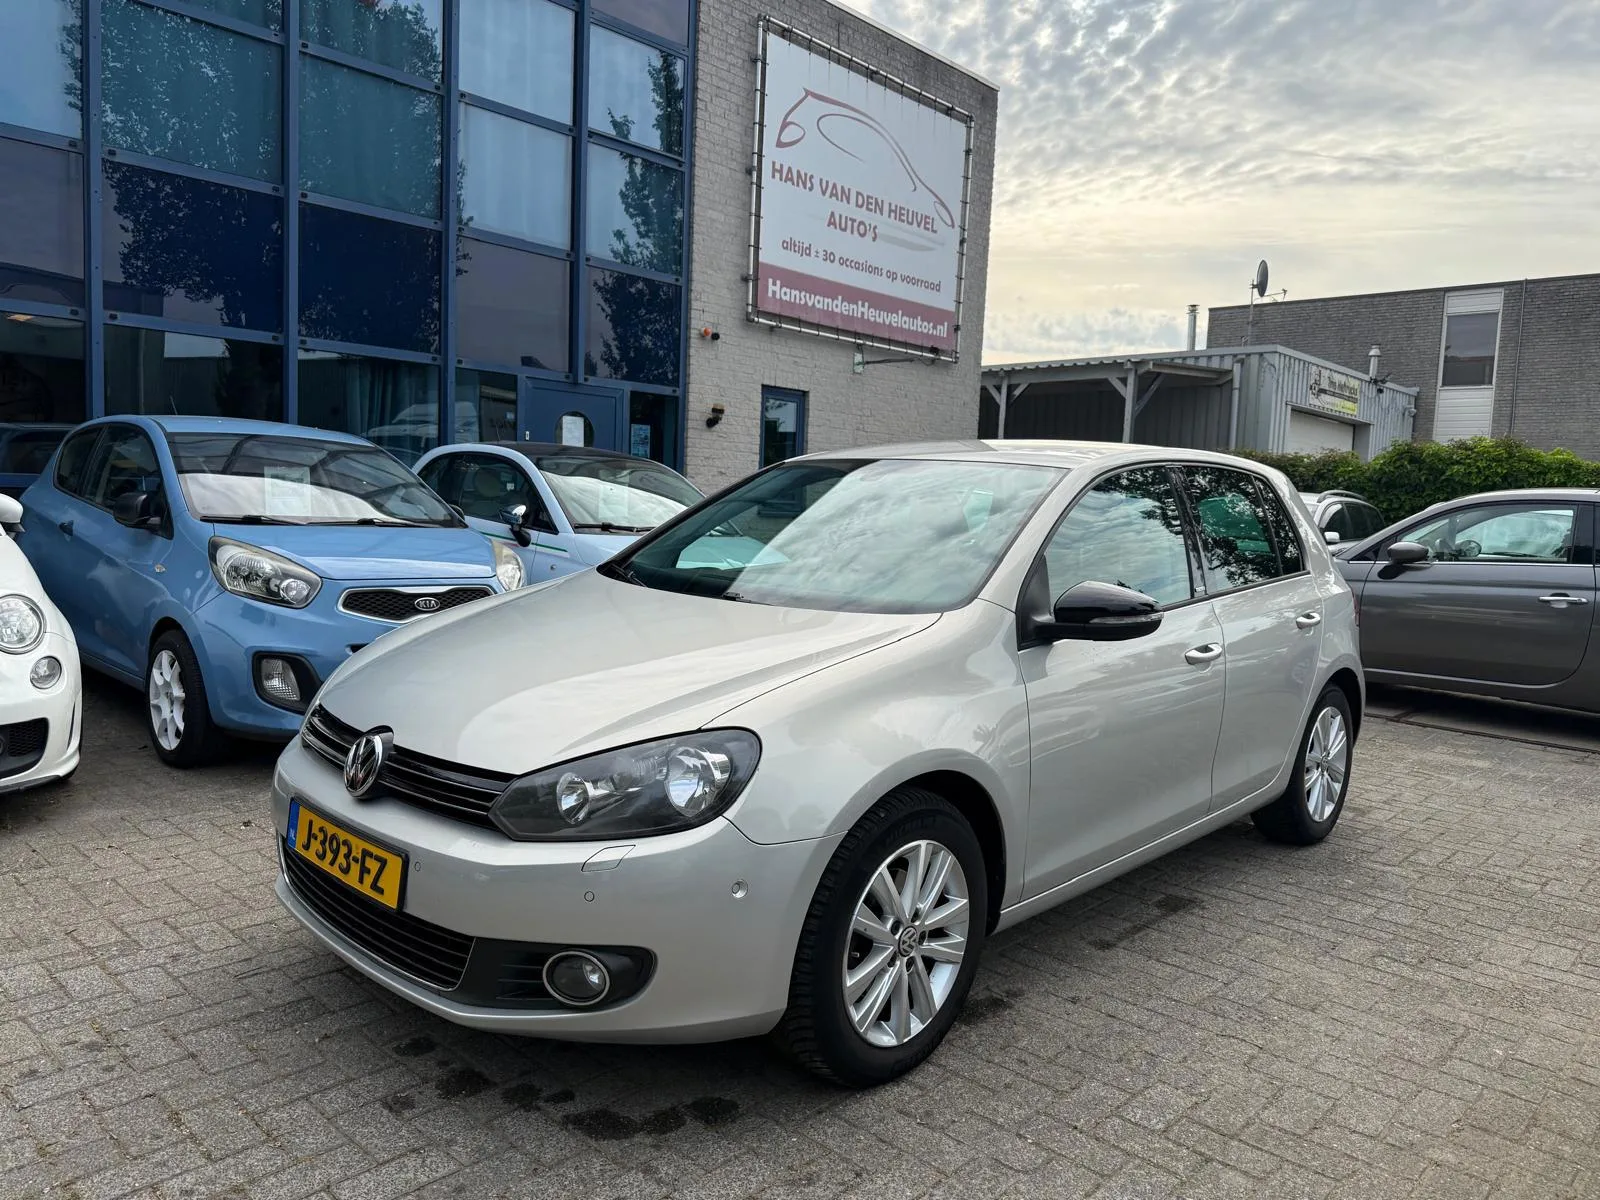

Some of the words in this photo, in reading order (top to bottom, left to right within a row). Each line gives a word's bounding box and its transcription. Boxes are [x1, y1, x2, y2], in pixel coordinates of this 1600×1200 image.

[771, 161, 814, 192] HANS
[819, 178, 851, 205] VAN
[855, 191, 884, 216] DEN
[888, 202, 938, 234] HEUVEL
[826, 211, 878, 242] AUTO'S
[781, 237, 812, 258] altijd
[822, 251, 836, 264] 30
[838, 257, 883, 278] occasions
[886, 269, 898, 283] op
[900, 273, 941, 293] voorraad
[767, 278, 948, 338] HansvandenHeuvelautos.nl
[419, 600, 437, 608] KIA
[301, 818, 388, 895] J-393-FZ
